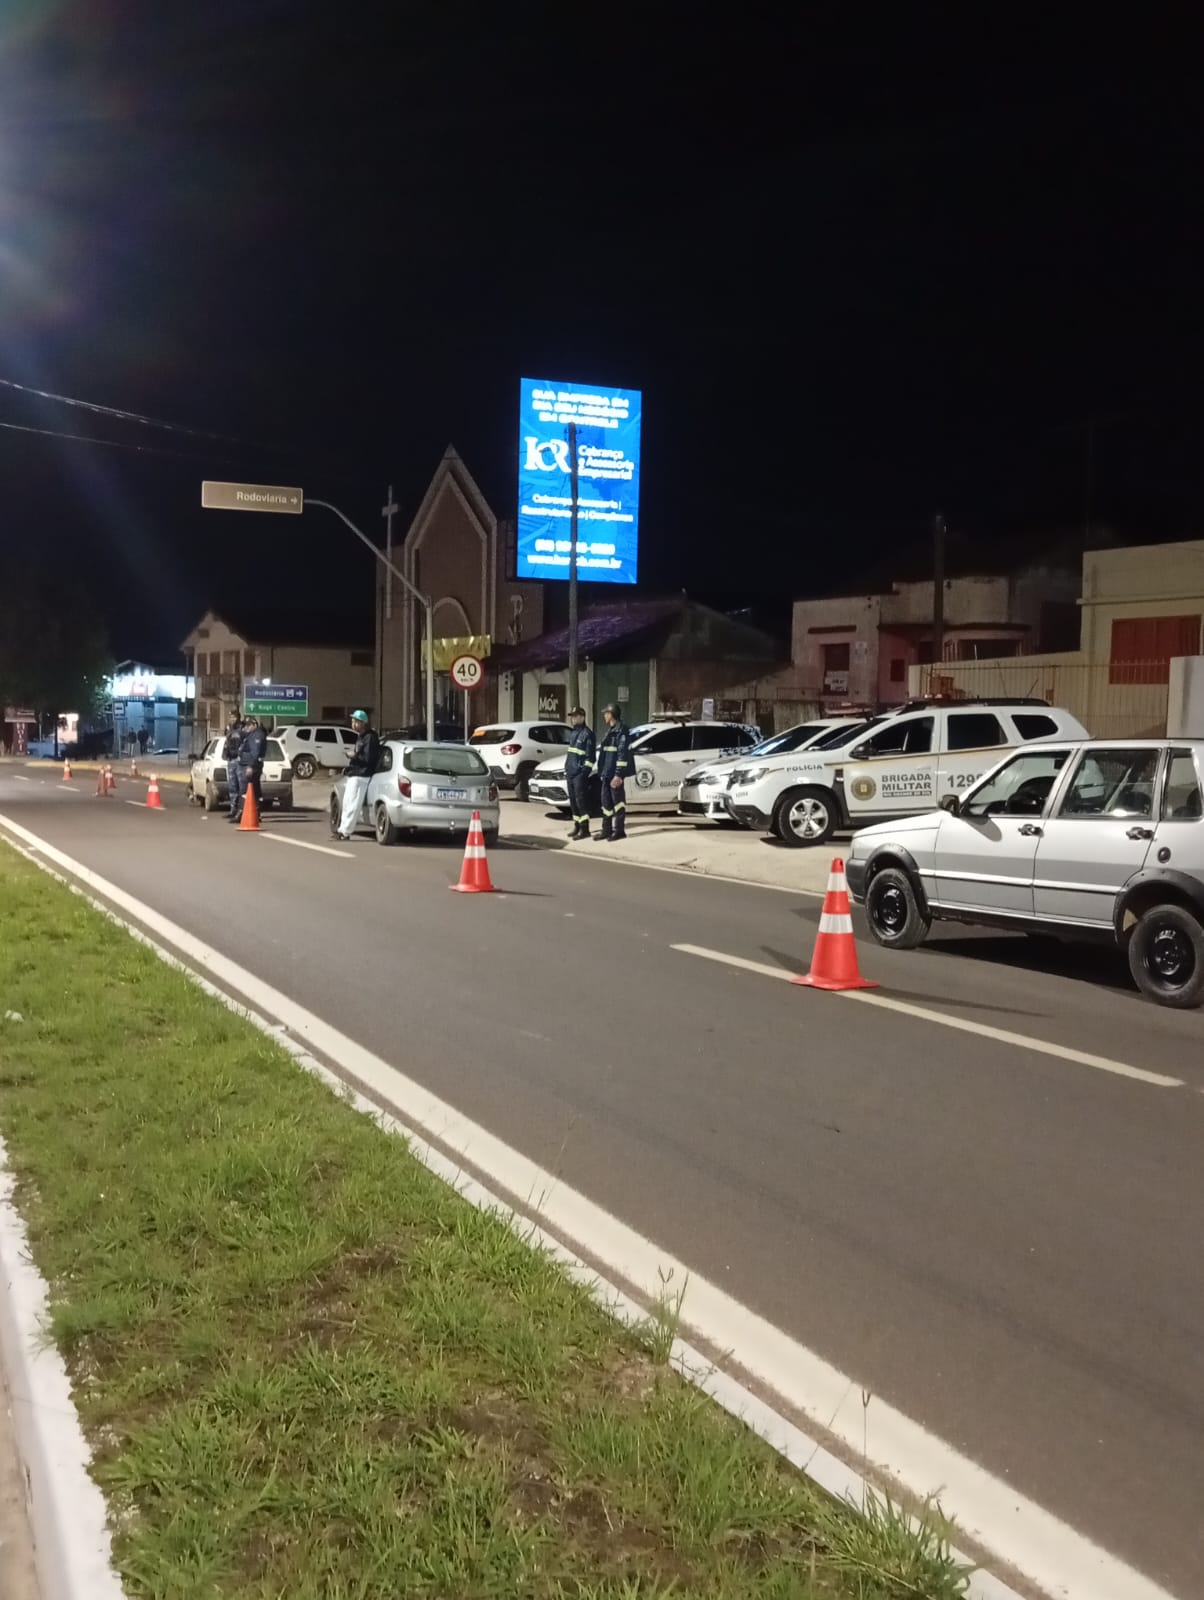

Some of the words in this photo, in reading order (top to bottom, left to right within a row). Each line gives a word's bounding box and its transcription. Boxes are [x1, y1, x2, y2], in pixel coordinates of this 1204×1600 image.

[457, 663, 477, 677] 40
[882, 773, 931, 783] BRIGADA
[882, 782, 932, 791] MILITAR
